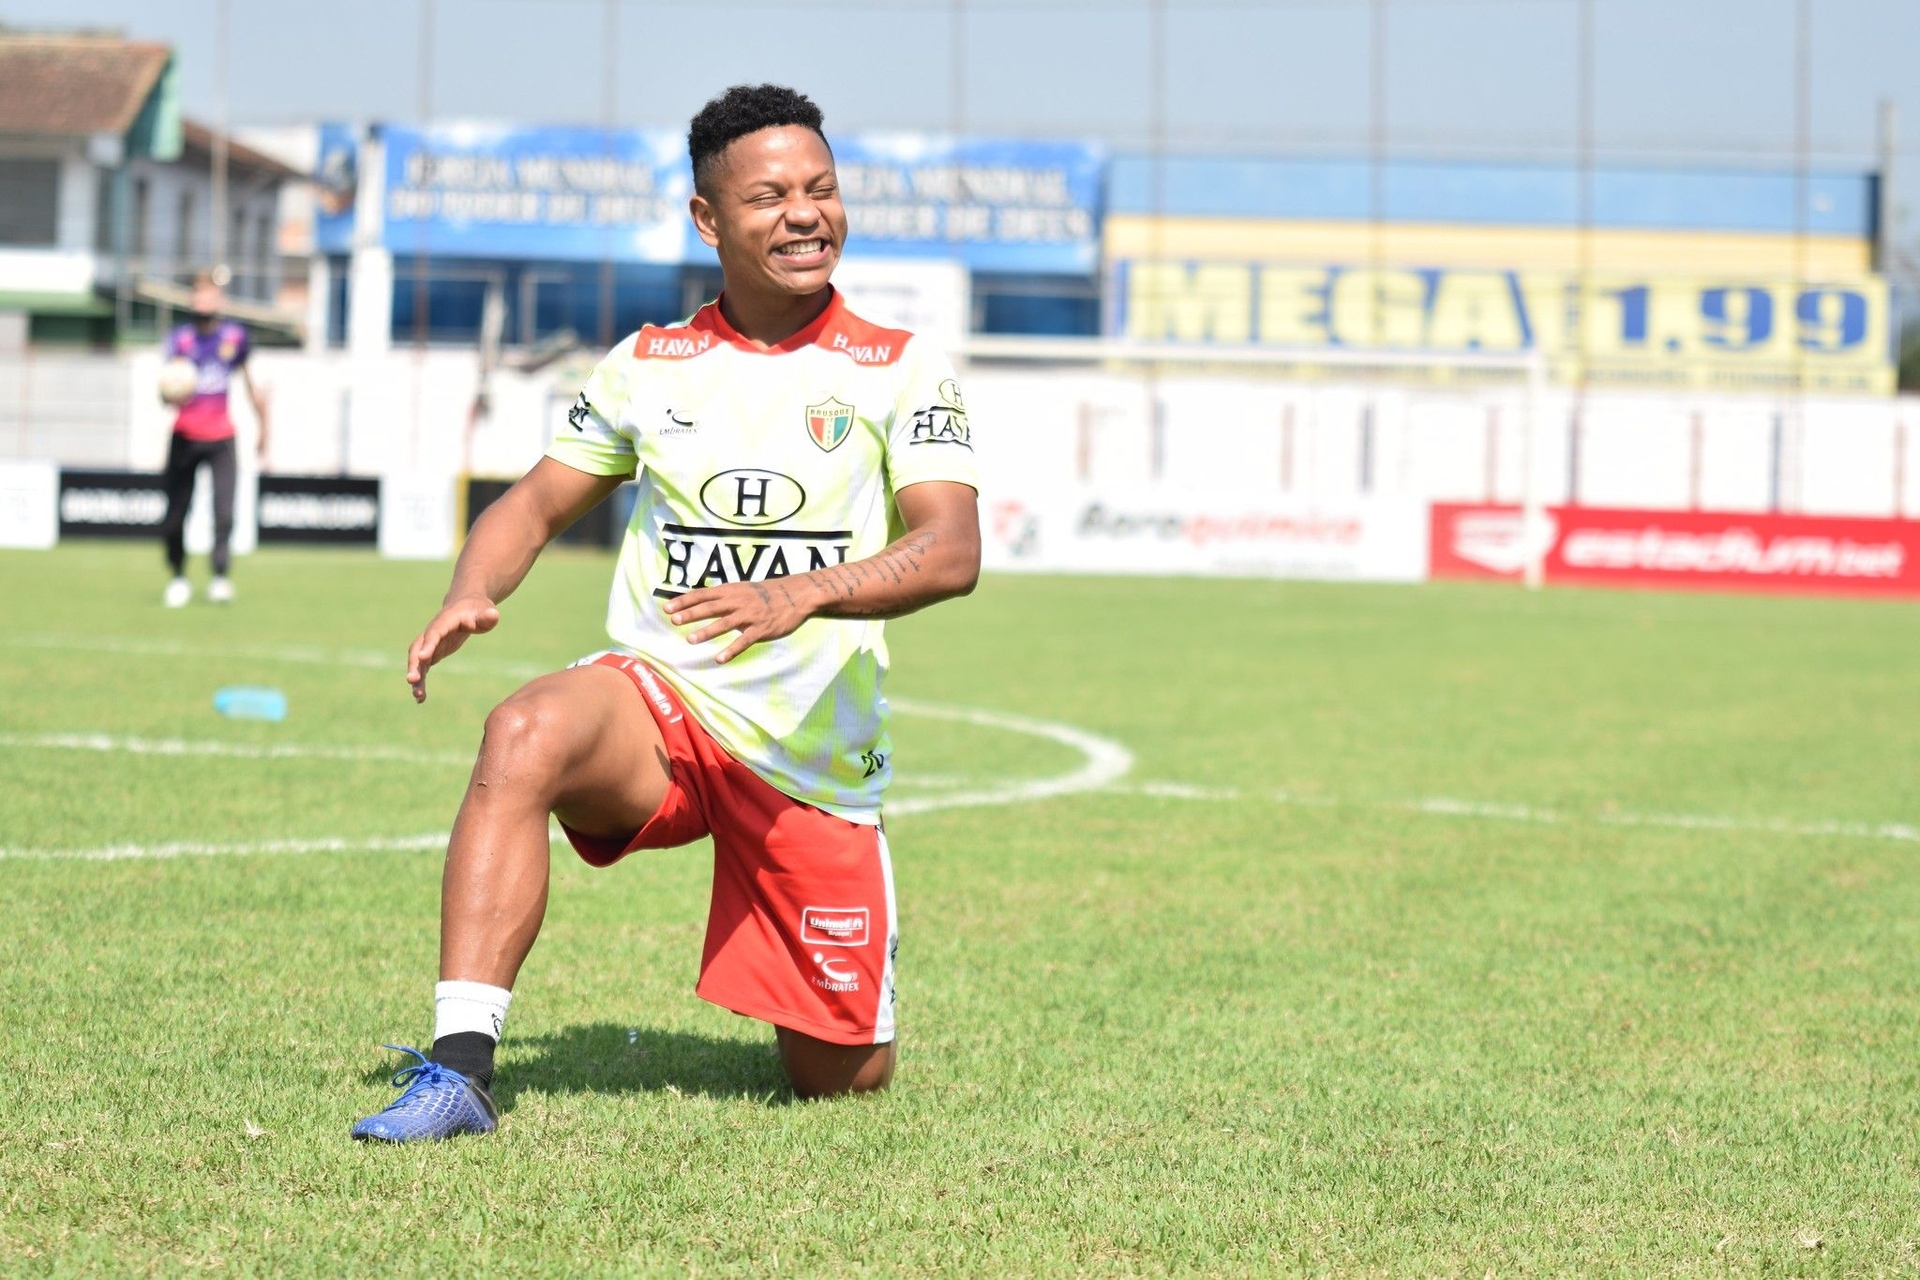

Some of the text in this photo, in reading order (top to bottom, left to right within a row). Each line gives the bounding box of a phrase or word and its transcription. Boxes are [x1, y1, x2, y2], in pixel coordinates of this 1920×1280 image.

[1122, 260, 1532, 350] MEGA
[1602, 284, 1868, 355] 1.99
[646, 334, 711, 357] HAVAN
[832, 333, 893, 363] HAVAN
[809, 408, 850, 418] BRUSQUE
[733, 476, 772, 517] H
